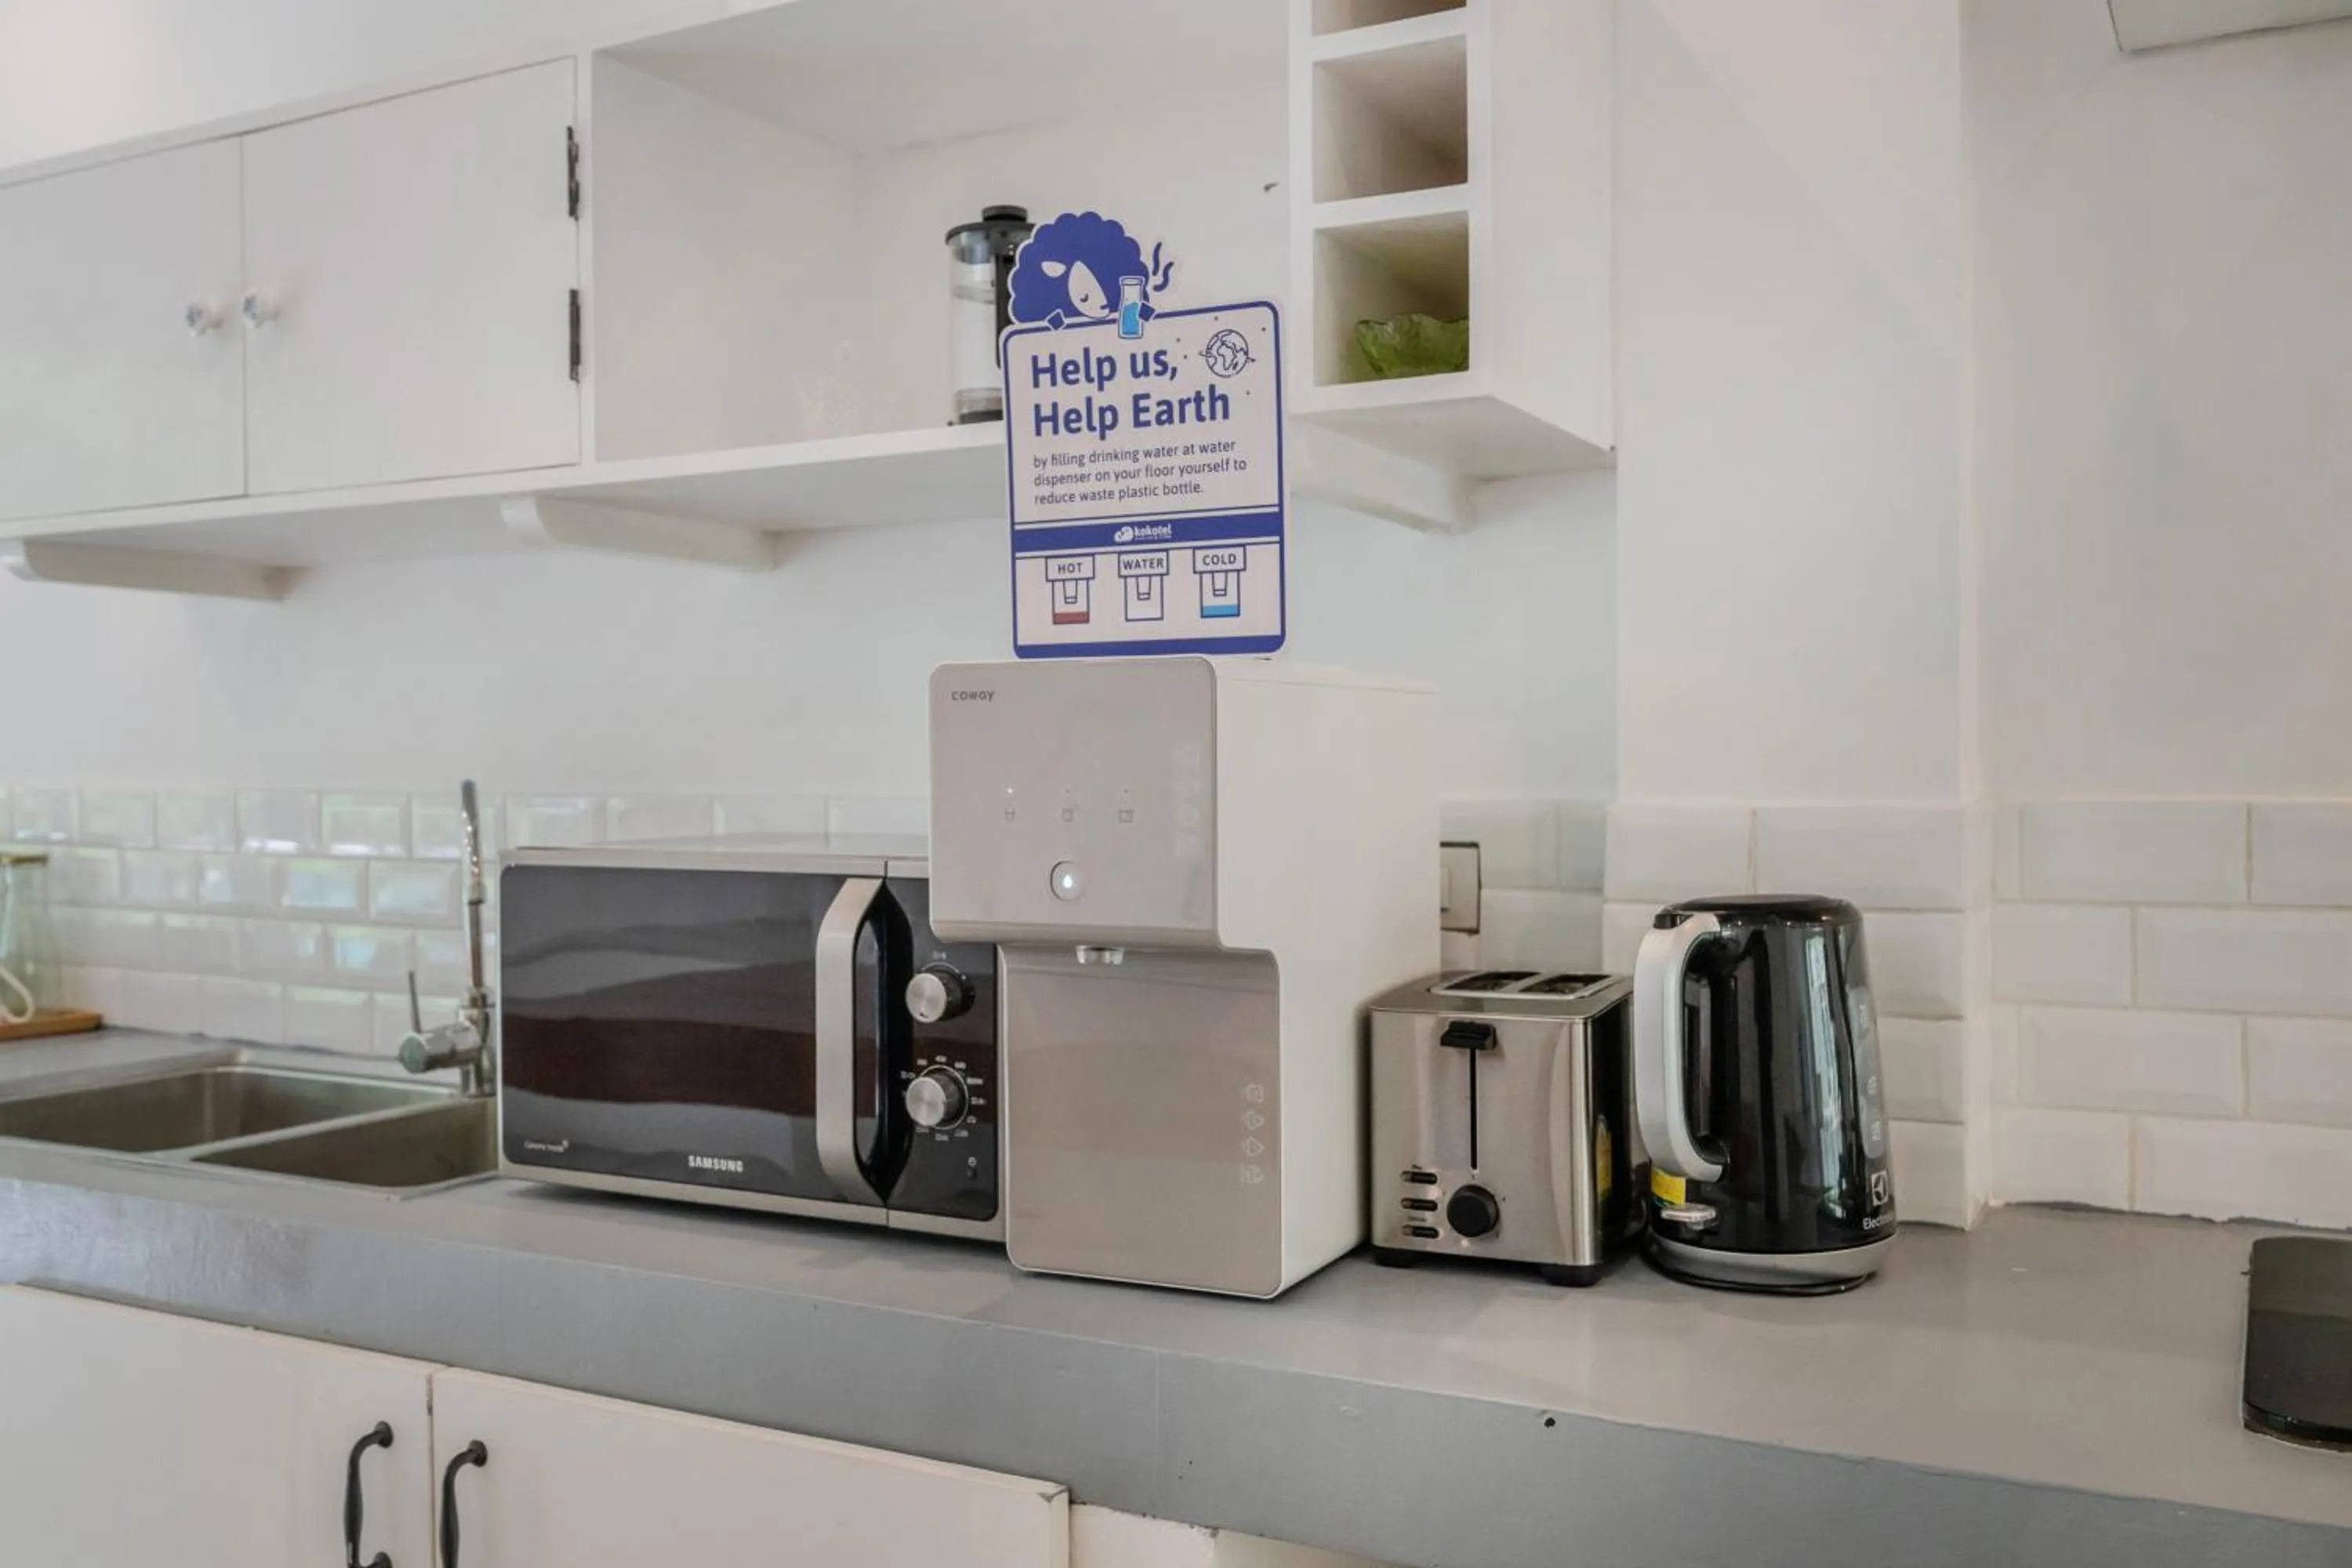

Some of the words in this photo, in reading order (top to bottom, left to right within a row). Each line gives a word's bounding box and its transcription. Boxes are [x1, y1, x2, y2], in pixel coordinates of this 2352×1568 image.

[1031, 347, 1116, 392] Help
[1130, 349, 1178, 381] us,
[1033, 396, 1119, 441] Help
[1132, 383, 1230, 429] Earth
[1033, 454, 1047, 470] by
[1051, 452, 1086, 468] filling
[1088, 449, 1140, 464] drinking
[1142, 445, 1179, 459] water
[1182, 444, 1195, 456] at
[1199, 441, 1236, 455] water
[1034, 472, 1092, 488] dispenser
[1094, 470, 1111, 482] on
[1114, 468, 1142, 483] your
[1145, 463, 1175, 478] floor
[1178, 457, 1230, 477] yourself
[1233, 458, 1247, 471] to
[1034, 492, 1076, 505] reduce
[1079, 488, 1115, 502] waste
[1119, 485, 1160, 503] plastic
[1163, 479, 1203, 496] bottle.
[1058, 562, 1083, 575] HOT
[1122, 557, 1164, 571] WATER
[1202, 554, 1237, 567] COLD
[951, 690, 996, 703] coway
[688, 1155, 743, 1174] SAMSUNG
